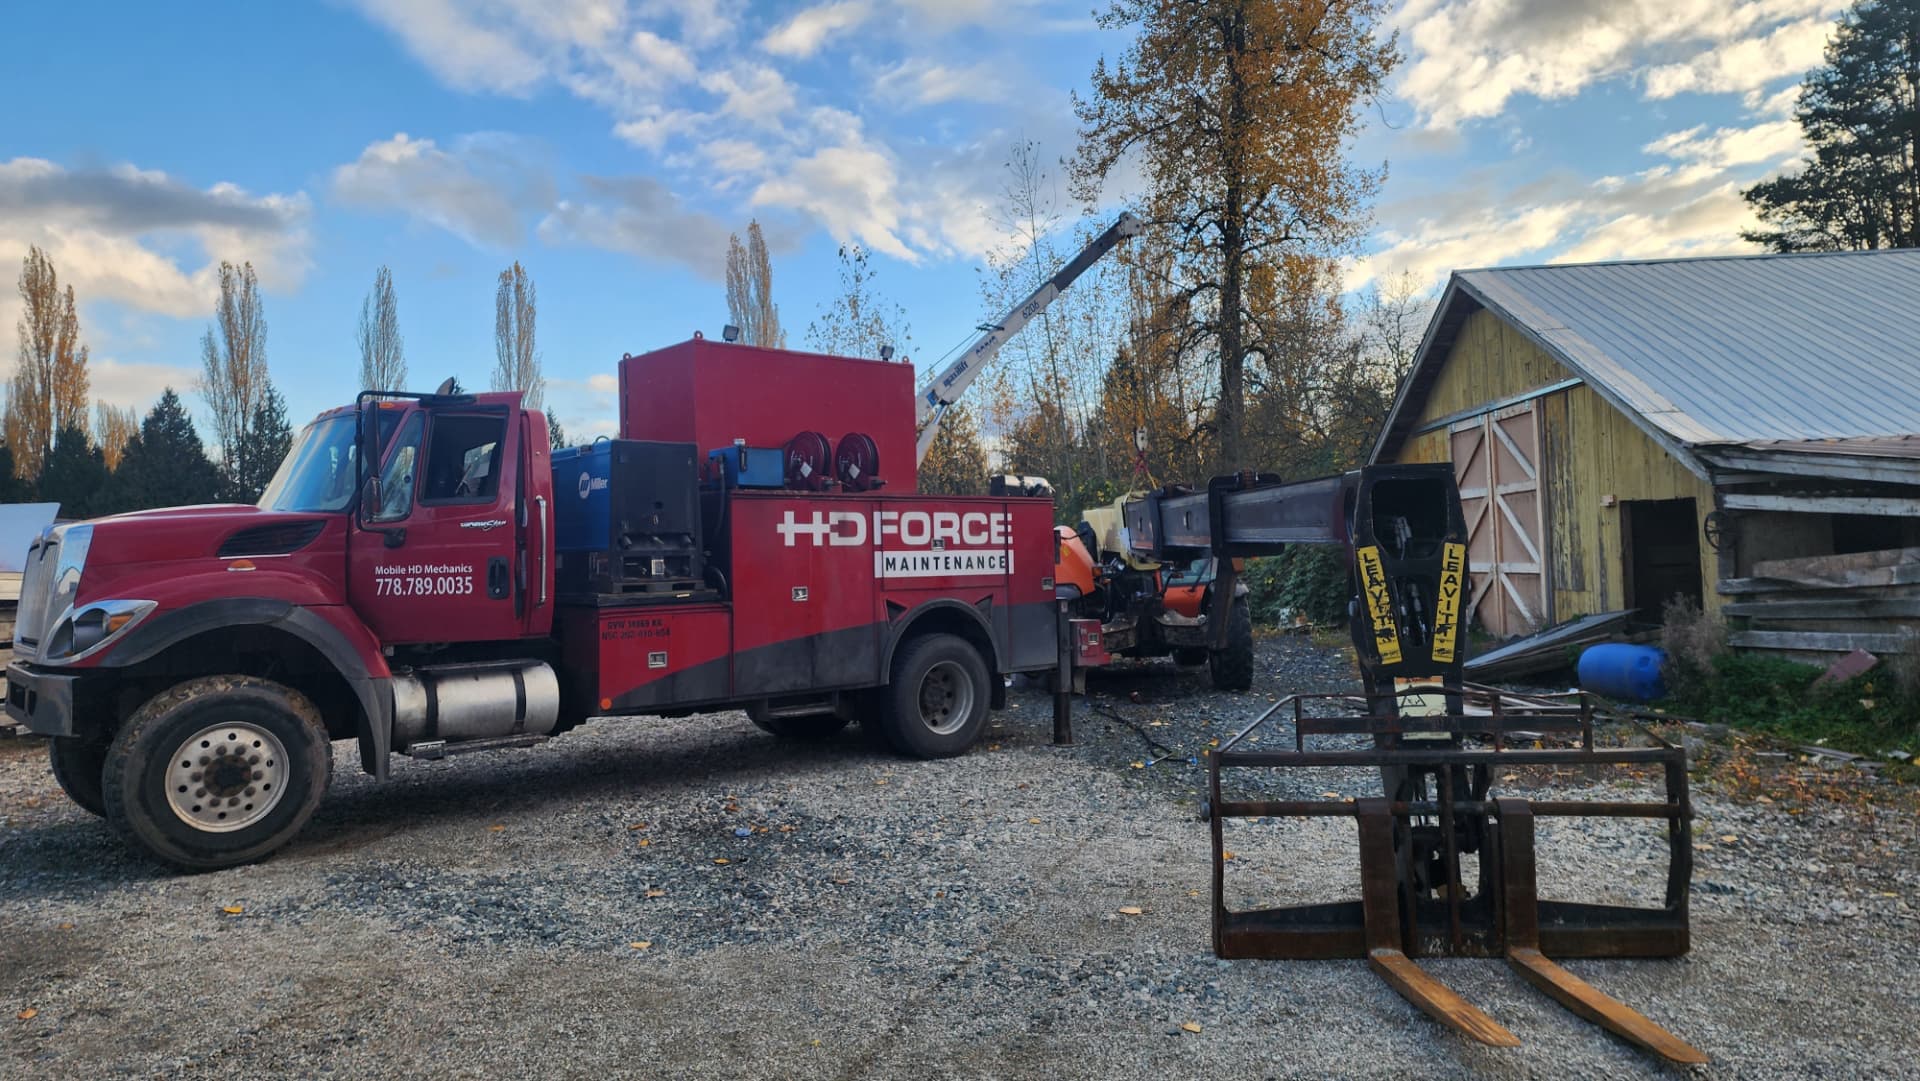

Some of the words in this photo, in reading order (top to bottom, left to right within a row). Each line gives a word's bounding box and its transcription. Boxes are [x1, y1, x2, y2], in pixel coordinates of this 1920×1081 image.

[1022, 301, 1040, 319] 6206
[776, 511, 867, 546] HD
[873, 511, 1014, 546] FORCE
[375, 565, 406, 575] Mobile
[408, 565, 423, 575] HD
[424, 563, 473, 574] Mechanics
[885, 555, 1007, 572] MAINTENANCE
[375, 576, 473, 596] 778.789.0035
